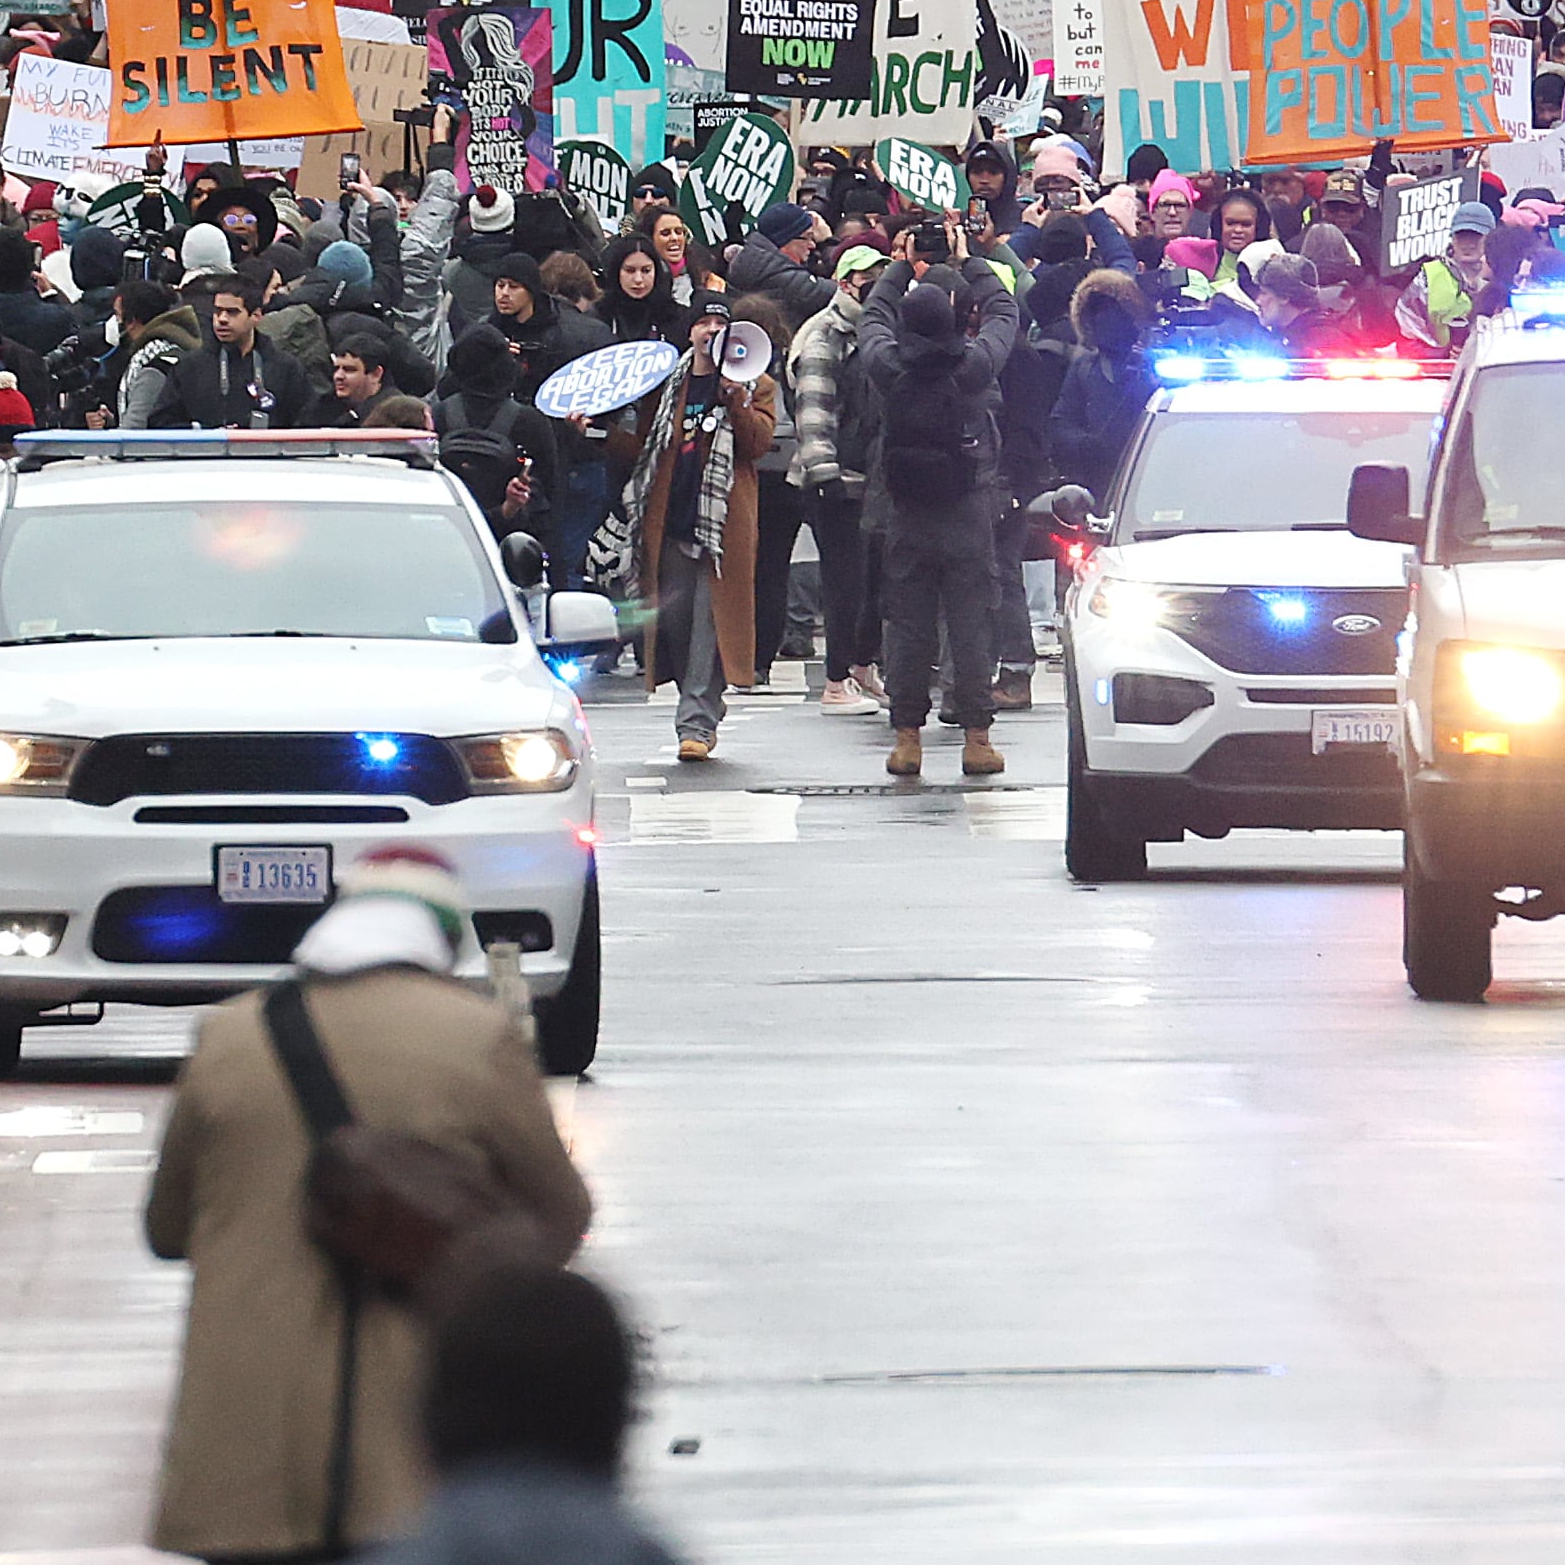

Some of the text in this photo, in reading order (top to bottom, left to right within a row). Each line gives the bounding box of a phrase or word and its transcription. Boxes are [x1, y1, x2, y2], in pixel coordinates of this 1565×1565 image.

[796, 2, 858, 22] RIGHTS
[1074, 3, 1093, 21] to
[740, 17, 856, 40] AMENDMENT
[1067, 25, 1097, 40] but
[762, 39, 835, 69] NOW
[1075, 45, 1103, 56] can
[21, 60, 109, 87] MY FUT
[1075, 59, 1100, 70] me
[122, 44, 323, 114] SILENT
[468, 80, 504, 90] NOT
[462, 90, 514, 106] YOUR
[1265, 65, 1495, 138] POWER
[470, 105, 511, 118] BODY
[697, 107, 748, 118] ABORTION
[49, 124, 93, 140] WAKE
[470, 130, 518, 143] YOUR
[1, 146, 71, 171] CLIMATE
[467, 141, 527, 165] CHOICE
[722, 116, 787, 184] ERA
[501, 163, 525, 174] OFF
[890, 138, 956, 188] ERA
[707, 155, 776, 218] NOW
[888, 159, 956, 210] NOW
[1398, 177, 1464, 215] TRUST
[1397, 201, 1458, 240] BLACK
[569, 343, 657, 374] KEEP
[541, 351, 673, 405] ABORTION
[551, 375, 656, 413] LEGAL
[257, 863, 318, 889] 13635
